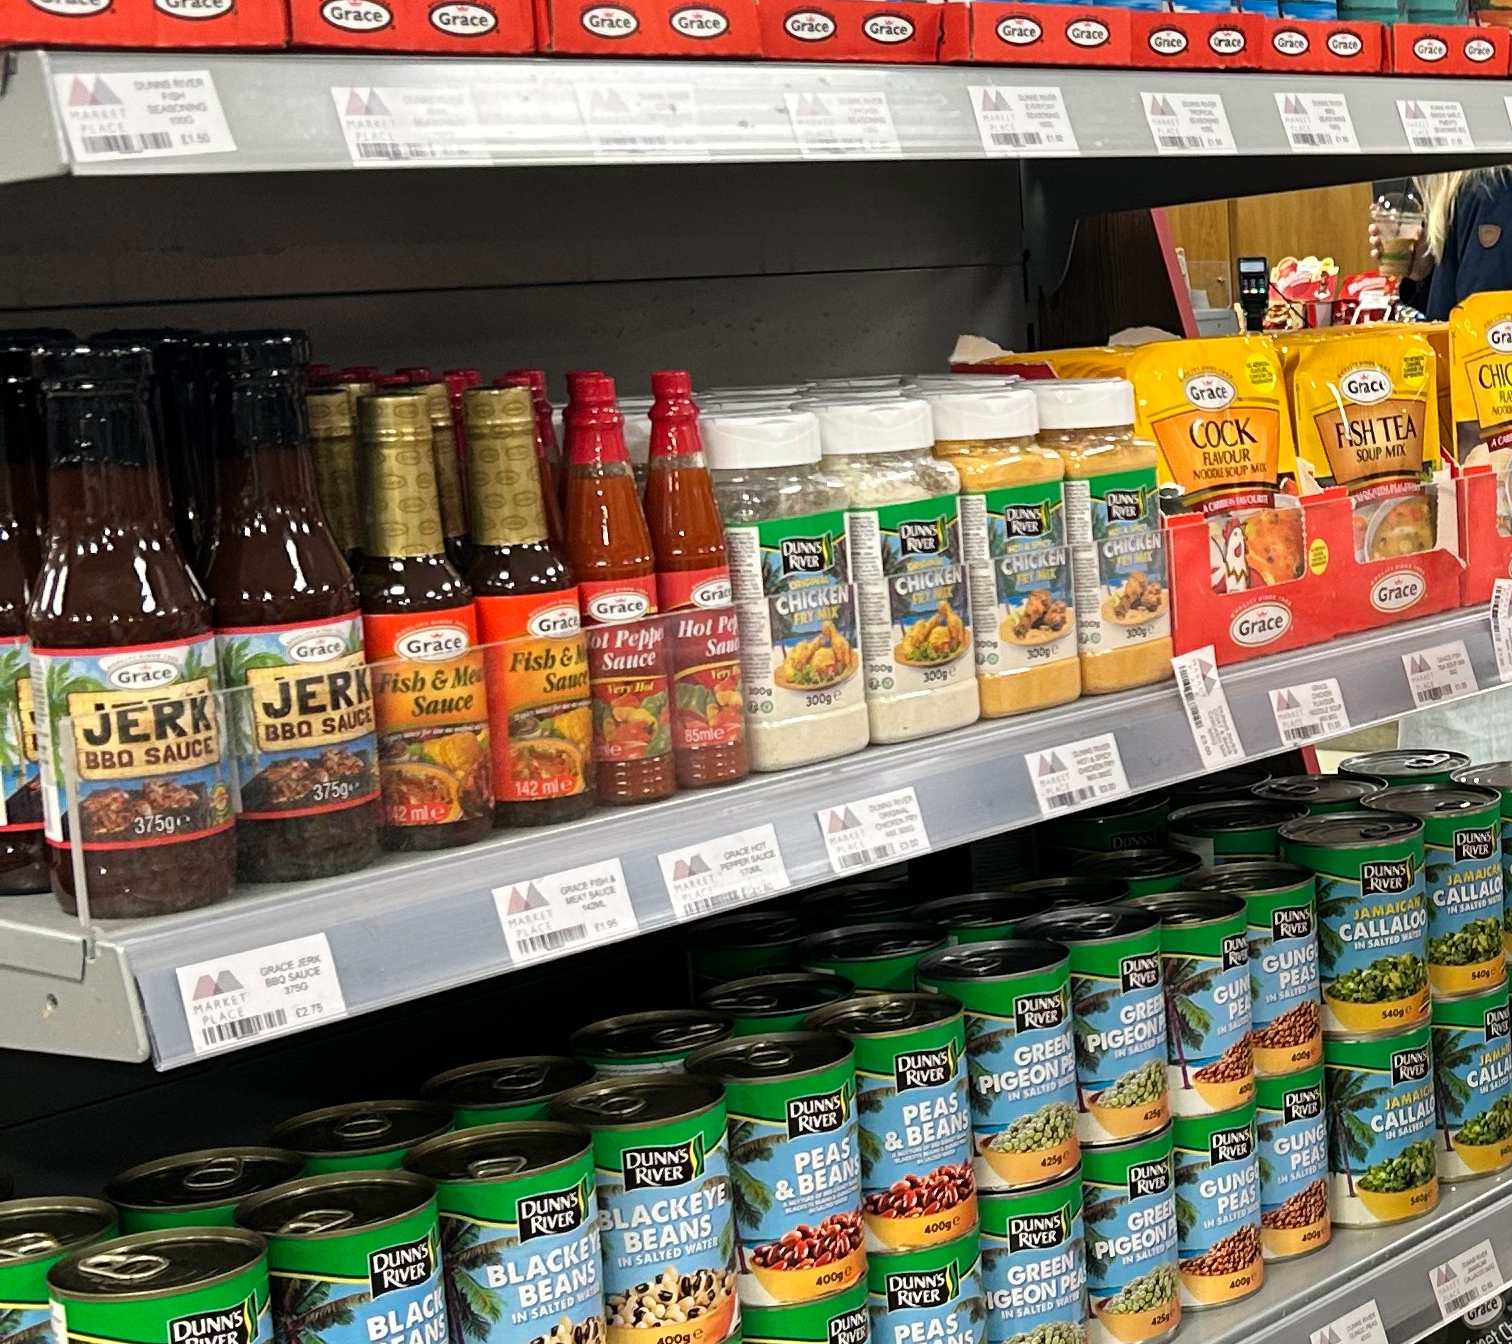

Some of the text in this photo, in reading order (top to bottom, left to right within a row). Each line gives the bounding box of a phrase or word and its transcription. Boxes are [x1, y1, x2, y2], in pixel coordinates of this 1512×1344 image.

[1188, 415, 1258, 450] COCK
[1336, 415, 1417, 450] FISH TEA
[1201, 448, 1252, 465] FLAVOUR
[1356, 443, 1407, 464] SOUP MIX
[1102, 534, 1161, 558] CHICKEN
[1000, 550, 1066, 576] CHICKEN
[895, 567, 963, 596] CHICKEN
[595, 599, 644, 615] Grace
[775, 585, 849, 615] CHICKEN
[792, 607, 839, 626] FRY MIX
[678, 619, 712, 639] Hot
[406, 635, 465, 655] Grace
[510, 647, 576, 673] Fish &
[601, 651, 657, 670] Sauce
[117, 667, 172, 687] Grace
[922, 668, 949, 683] 300g
[262, 668, 371, 719] JERK
[606, 681, 654, 697] Very Hot
[411, 695, 474, 718] Sauce
[805, 693, 832, 708] 300g
[82, 693, 214, 746] JERK
[265, 708, 372, 742] BBQ SAUCE
[684, 727, 714, 742] 85ml
[85, 737, 214, 770] BBQ SAUCE
[312, 780, 349, 802] 375g
[514, 778, 560, 795] 142 ml
[133, 814, 175, 836] 375g
[1352, 898, 1422, 920] JAMAICAN
[1338, 911, 1427, 942] CALLALOO
[260, 955, 321, 977] GRACE JERK
[265, 966, 320, 988] BBQ SAUCE
[284, 983, 308, 995] 375G
[296, 1003, 323, 1018] £2.75
[1380, 1007, 1405, 1022] 540g
[1217, 1188, 1256, 1213] PEAS
[1009, 1213, 1061, 1237] DUNN'S
[1018, 1229, 1057, 1248] RIVER
[1007, 1255, 1074, 1287] GREEN
[888, 1272, 945, 1294] DUNN'S
[898, 1287, 941, 1307] RIVER
[172, 1303, 244, 1337] DUNN'S
[894, 1314, 958, 1344] PEAS
